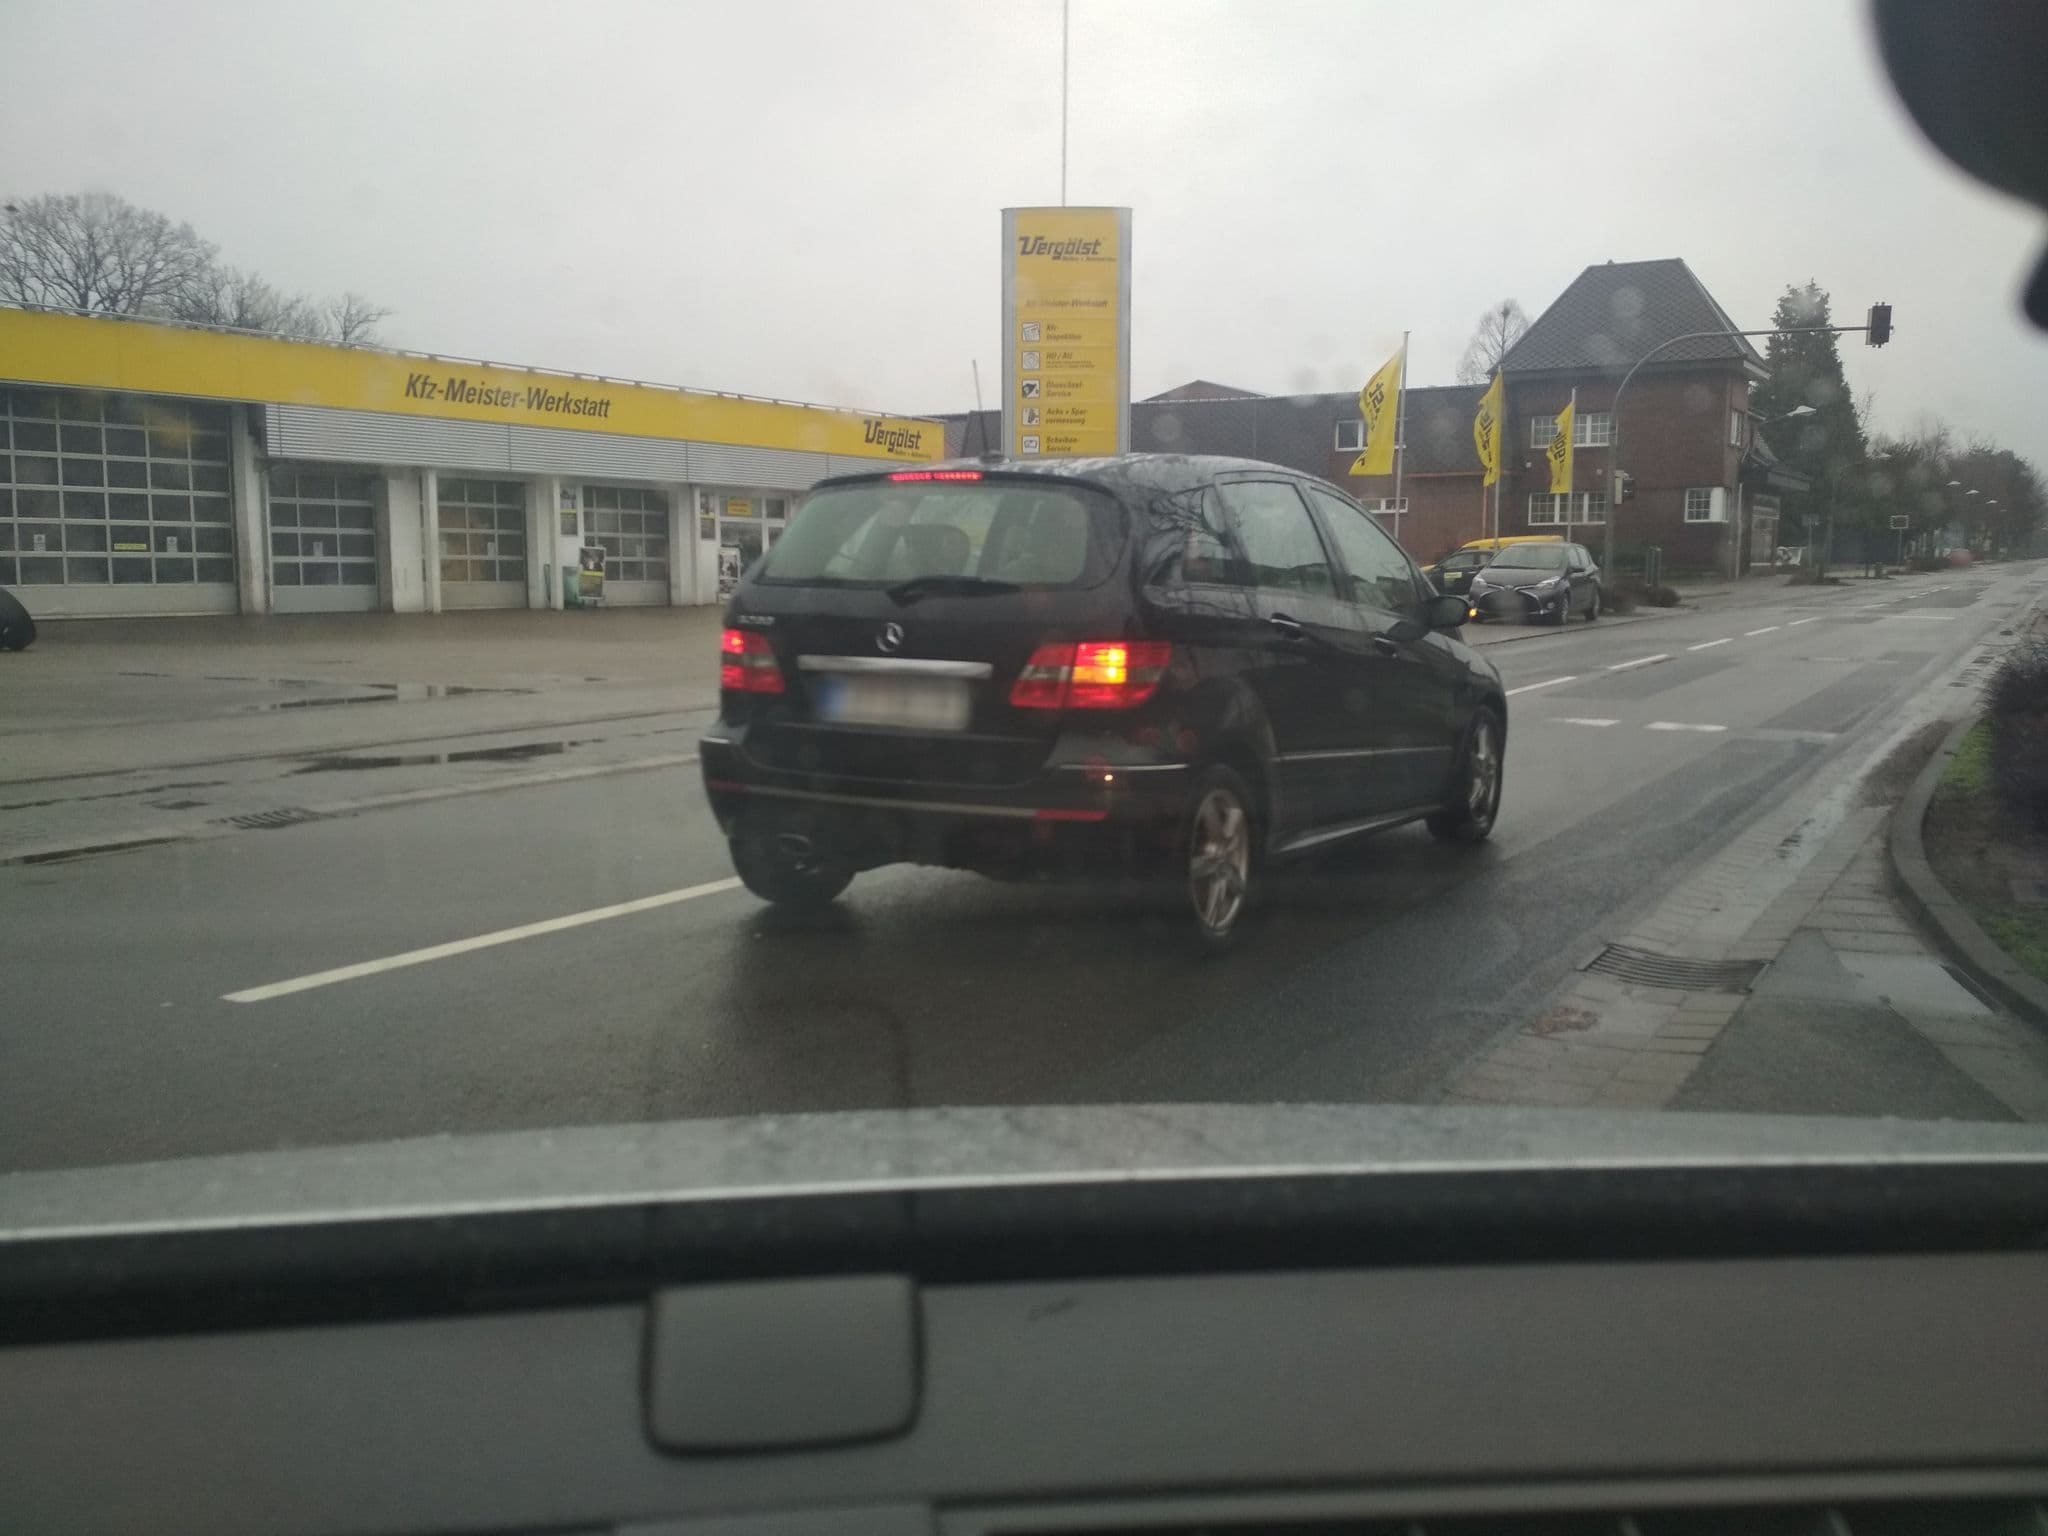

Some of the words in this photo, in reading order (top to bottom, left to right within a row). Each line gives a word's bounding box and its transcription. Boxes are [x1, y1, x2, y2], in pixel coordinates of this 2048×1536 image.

[1018, 236, 1102, 260] Vergölst
[404, 372, 611, 418] Kfz-Meister-Werkstatt
[863, 419, 922, 453] Vergölst
